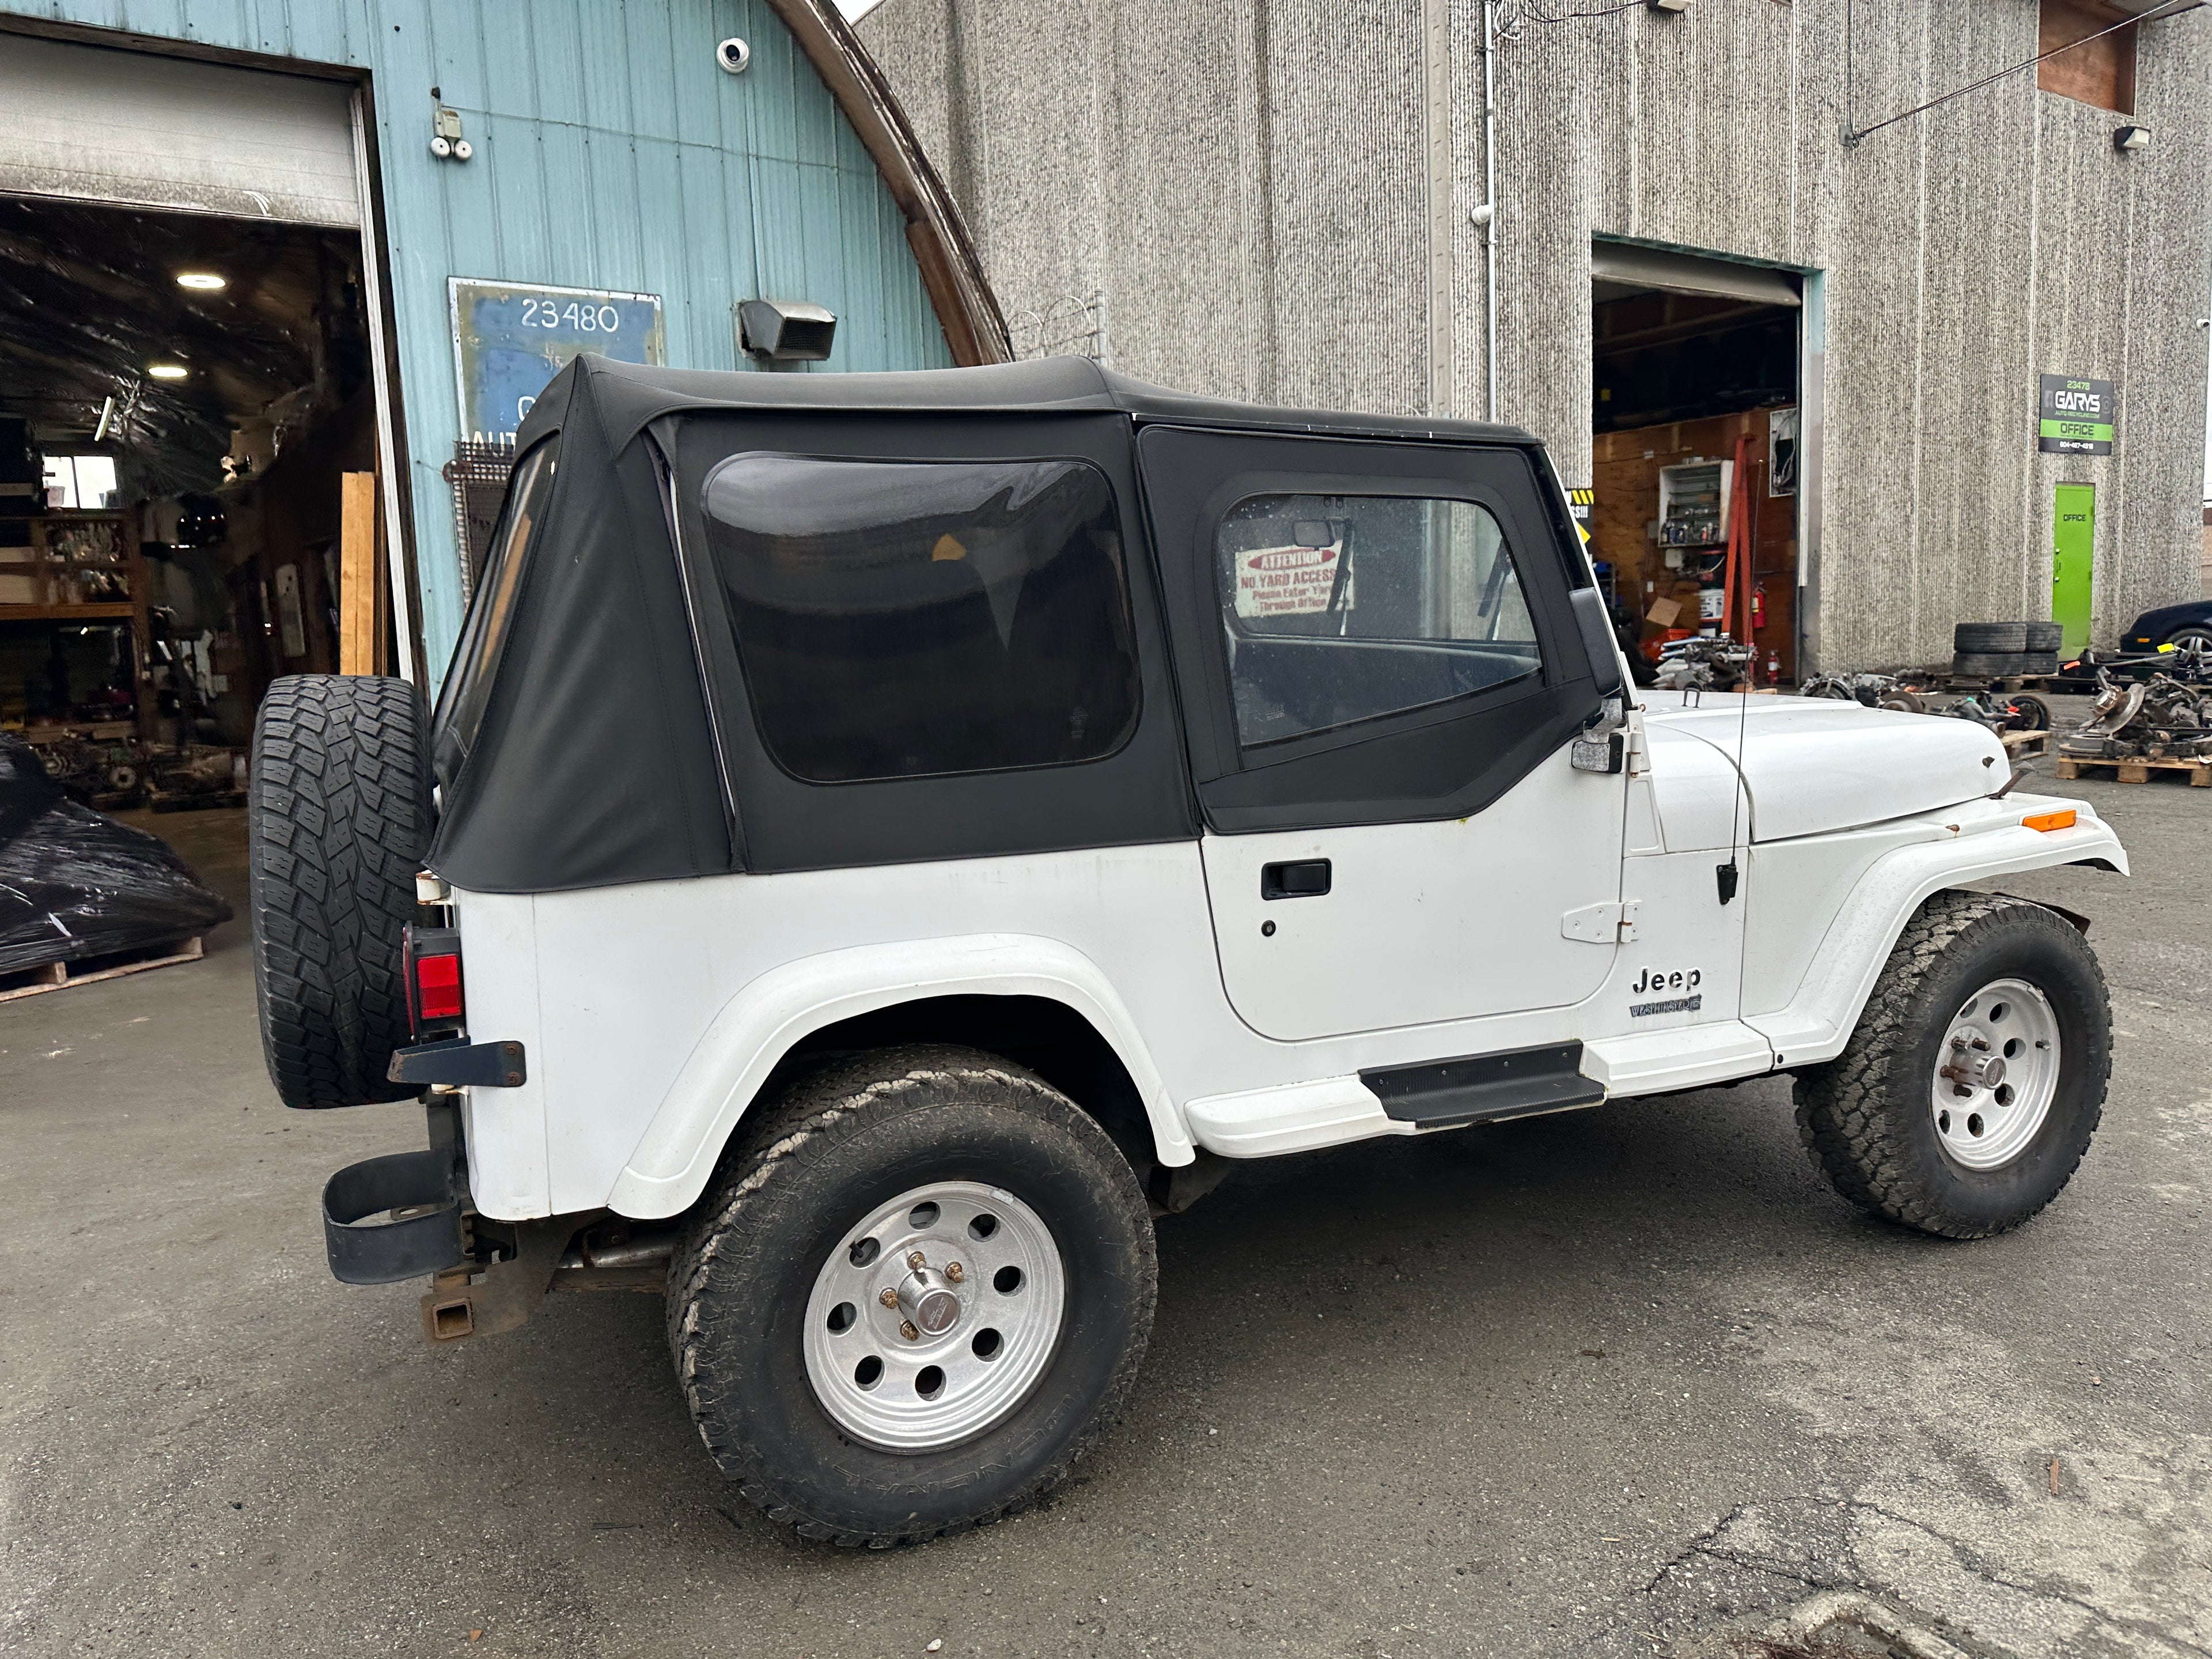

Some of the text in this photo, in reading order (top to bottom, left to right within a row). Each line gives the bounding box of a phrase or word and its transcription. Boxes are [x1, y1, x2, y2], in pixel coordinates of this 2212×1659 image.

[521, 298, 619, 332] 23480
[2055, 391, 2100, 412] GARYS
[2061, 423, 2094, 435] OFFICE
[472, 431, 517, 459] AUT
[1261, 551, 1322, 569] ATTENTION
[1241, 569, 1336, 588] NO YARD ACCESS
[1632, 968, 1701, 994] Jeep
